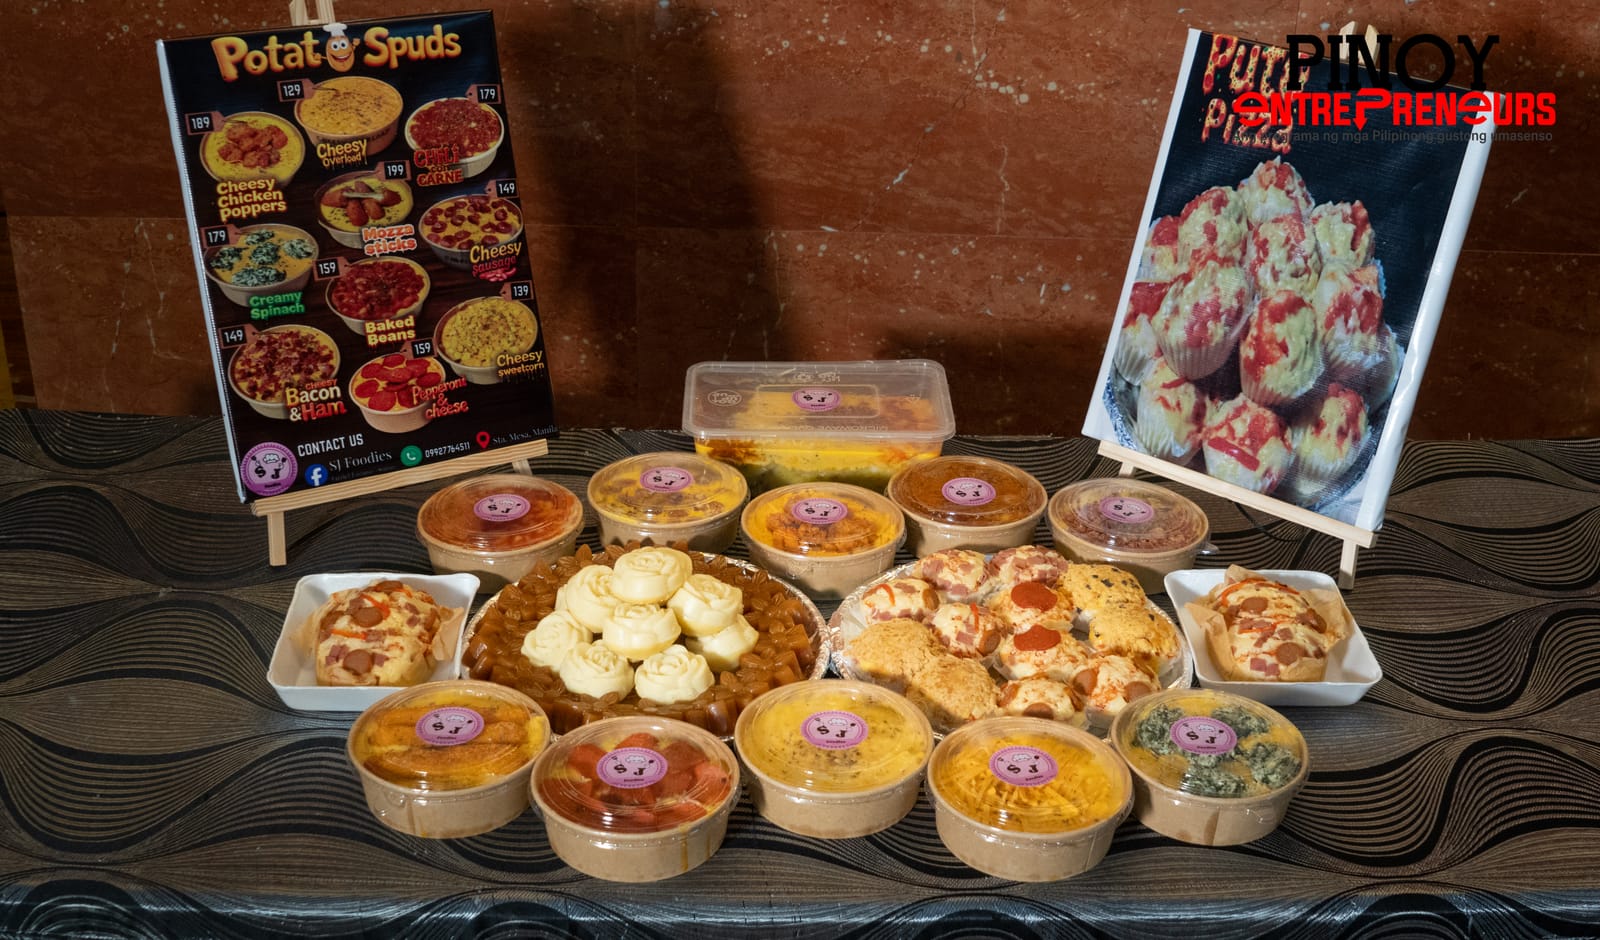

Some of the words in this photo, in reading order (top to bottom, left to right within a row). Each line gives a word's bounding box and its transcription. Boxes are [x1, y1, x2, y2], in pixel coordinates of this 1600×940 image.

[363, 24, 462, 69] Spuds
[283, 84, 301, 97] 129
[479, 88, 496, 100] 179
[191, 117, 210, 130] 189
[316, 139, 368, 161] Cheesy
[387, 164, 404, 177] 199
[417, 169, 464, 186] CARNE
[216, 178, 275, 195] Cheesy
[498, 183, 515, 194] 149
[217, 189, 283, 209] Chicken
[219, 200, 287, 222] Poppers
[207, 230, 226, 243] 179
[361, 224, 415, 241] Mozza
[364, 238, 417, 257] sticks
[469, 242, 522, 264] Cheesy
[319, 262, 336, 275] 159
[472, 255, 517, 275] sausage
[249, 291, 303, 307] Creamy
[513, 285, 529, 297] 139
[250, 302, 305, 319] Spinach
[365, 315, 415, 334] Baked
[223, 329, 243, 343] 149
[367, 328, 416, 346] Beans
[414, 342, 431, 355] 159
[496, 351, 543, 367] Cheesy
[498, 361, 545, 377] sweetcorn
[285, 385, 341, 407] Bacon
[412, 376, 467, 405] Pepperoni
[436, 393, 449, 407] &
[425, 400, 469, 419] cheese
[297, 436, 346, 457] CONTACT
[348, 433, 364, 447] US
[344, 451, 393, 468] Foodies
